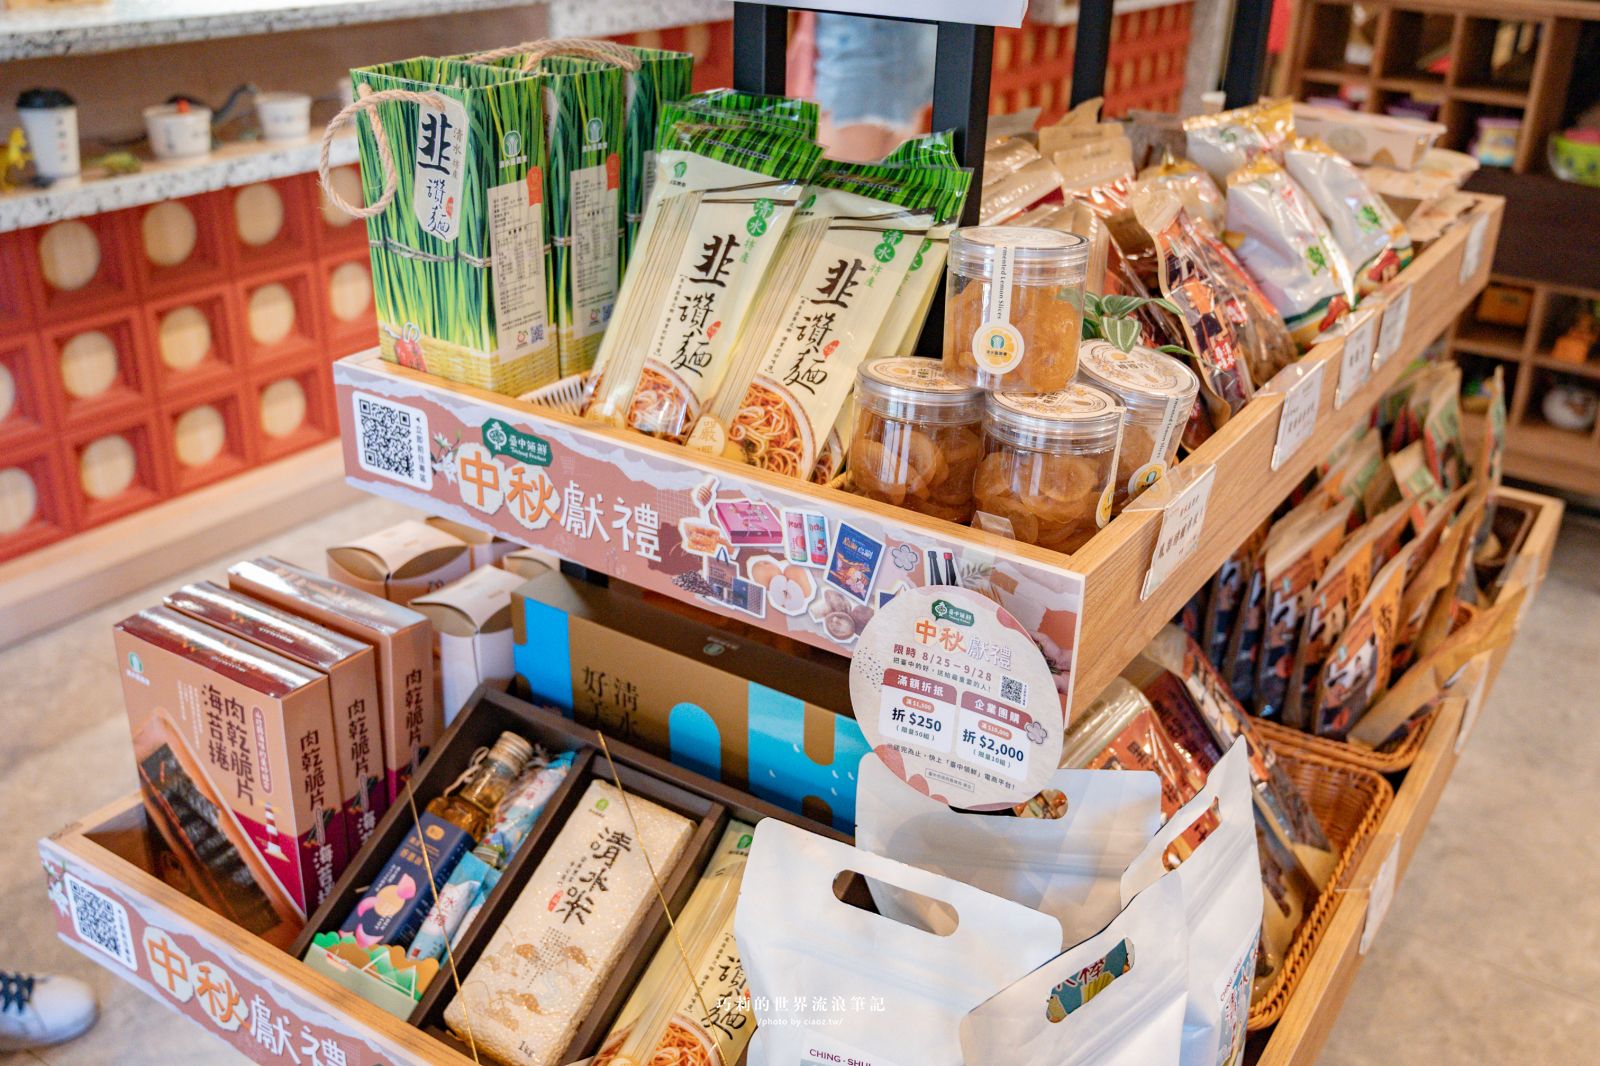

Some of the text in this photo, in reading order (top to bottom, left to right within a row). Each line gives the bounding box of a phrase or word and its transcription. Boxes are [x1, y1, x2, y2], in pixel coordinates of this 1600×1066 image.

[461, 451, 662, 562] 中秋獻禮
[893, 643, 917, 658] 限時
[915, 619, 1013, 671] 中秋獻禮
[406, 668, 424, 744] 肉乾脆片
[897, 674, 944, 697] 滿額折抵
[348, 699, 371, 778] 肉乾脆片
[891, 707, 942, 732] 折 $250
[962, 728, 1024, 762] 折 $2,000
[224, 697, 255, 806] 肉乾脆片
[300, 731, 326, 811] 肉乾脆片
[809, 1048, 841, 1063] CHING
